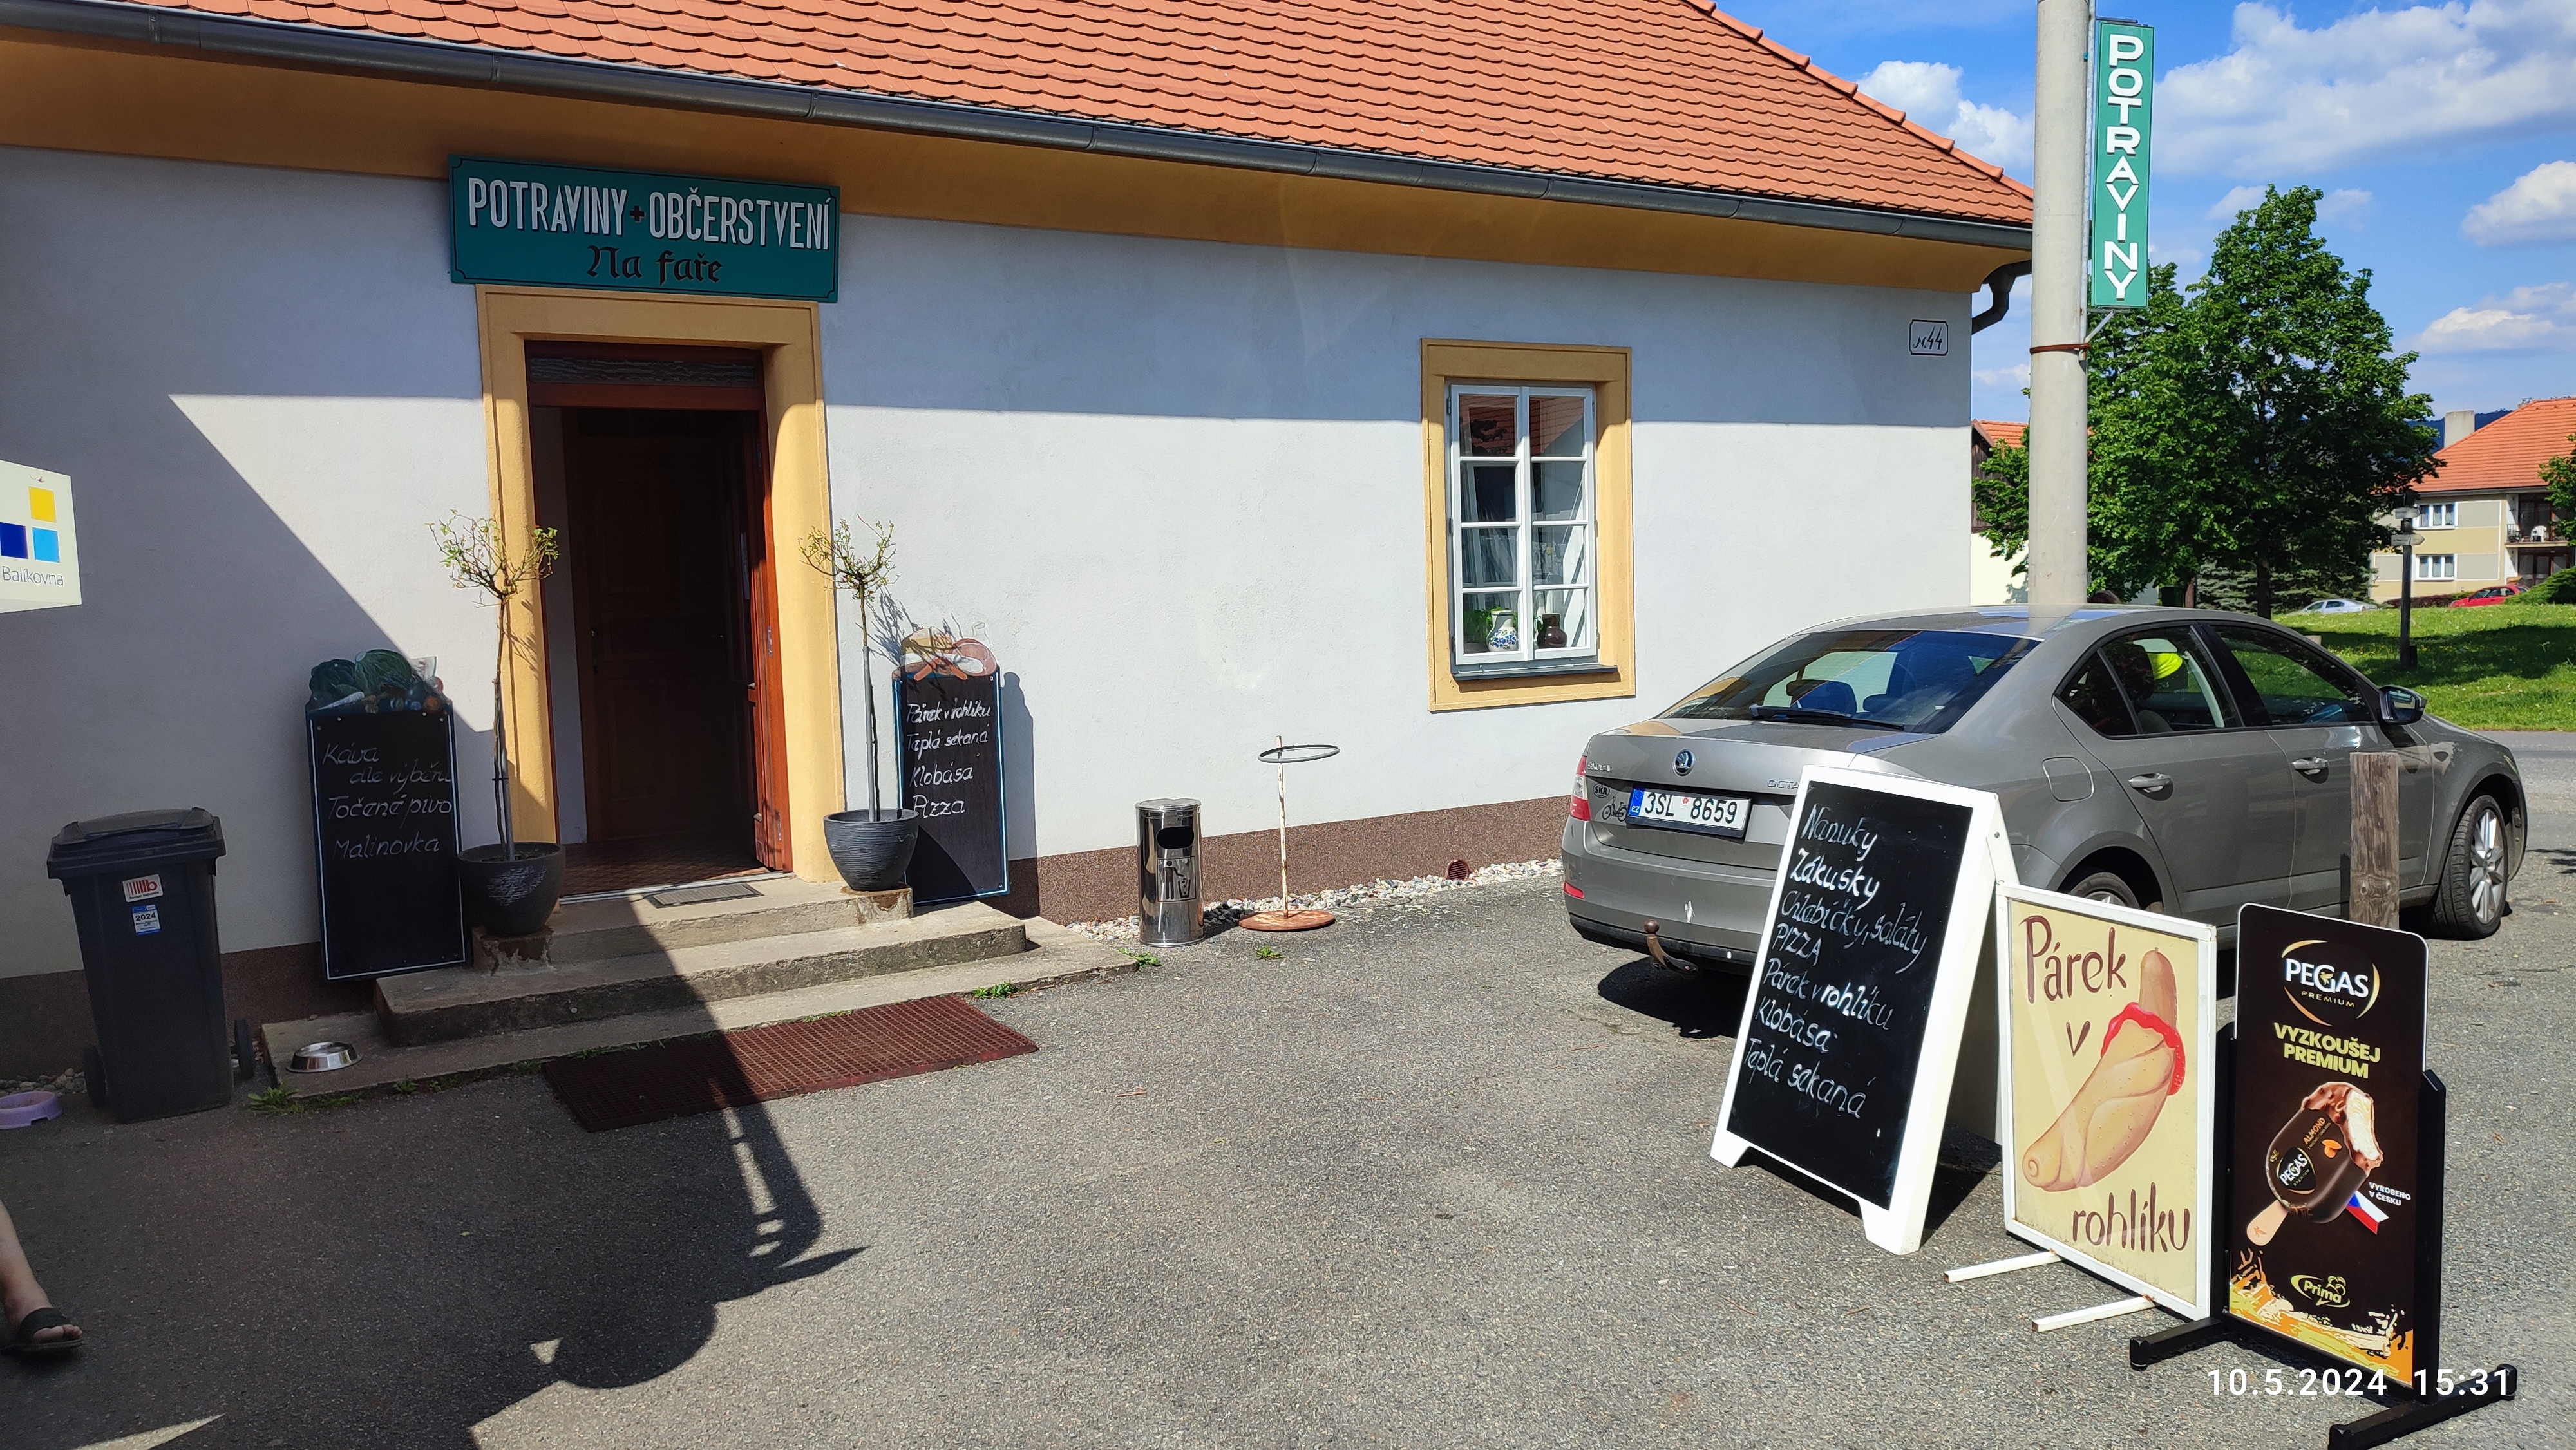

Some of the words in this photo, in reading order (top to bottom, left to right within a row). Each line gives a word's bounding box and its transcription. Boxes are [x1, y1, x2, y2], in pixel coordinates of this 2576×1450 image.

[2103, 33, 2145, 300] POTRAVINY
[468, 177, 627, 236] POTRAVINY
[649, 187, 831, 250] OBČERSTVENÍ
[587, 245, 643, 279] Na
[655, 250, 723, 287] faře
[2, 565, 64, 586] Balíkovna
[906, 701, 943, 723] Párek
[322, 742, 379, 766] Káva
[350, 766, 383, 785] dle
[910, 761, 974, 787] Klobása
[1767, 779, 1800, 789] OCTA
[328, 794, 408, 820] Točené
[399, 795, 453, 829] pivo
[912, 795, 965, 818] Pizza
[1645, 792, 1674, 817] 3SL
[1690, 796, 1738, 824] 8659
[332, 831, 440, 859] Malinovka
[1800, 802, 1878, 862] Nanuky
[1790, 847, 1880, 911] Zákusky
[135, 912, 156, 922] 2024
[1772, 923, 1822, 966] PIZZA
[2018, 914, 2127, 1004] Párek
[1763, 957, 1811, 999] Párek
[1812, 984, 1823, 1001] v
[1820, 982, 1894, 1030] rohlíku
[2285, 957, 2369, 998] PEGAS
[2301, 990, 2356, 1009] PREMIUM
[1755, 995, 1831, 1053] Klobása
[2066, 1020, 2090, 1057] v
[2274, 1022, 2381, 1063] VYZKOUŠEJ
[2284, 1042, 2369, 1079] PREMIUM
[1744, 1037, 1790, 1084] Teplá
[1786, 1060, 1877, 1119] sekaná
[2302, 1116, 2326, 1145] ALMOND
[2279, 1153, 2308, 1186] PEGAS
[2369, 1182, 2411, 1201] VYROBENO
[2376, 1191, 2401, 1206] ČESKU
[2072, 1182, 2191, 1254] rohlíku
[2304, 1279, 2342, 1304] Prima
